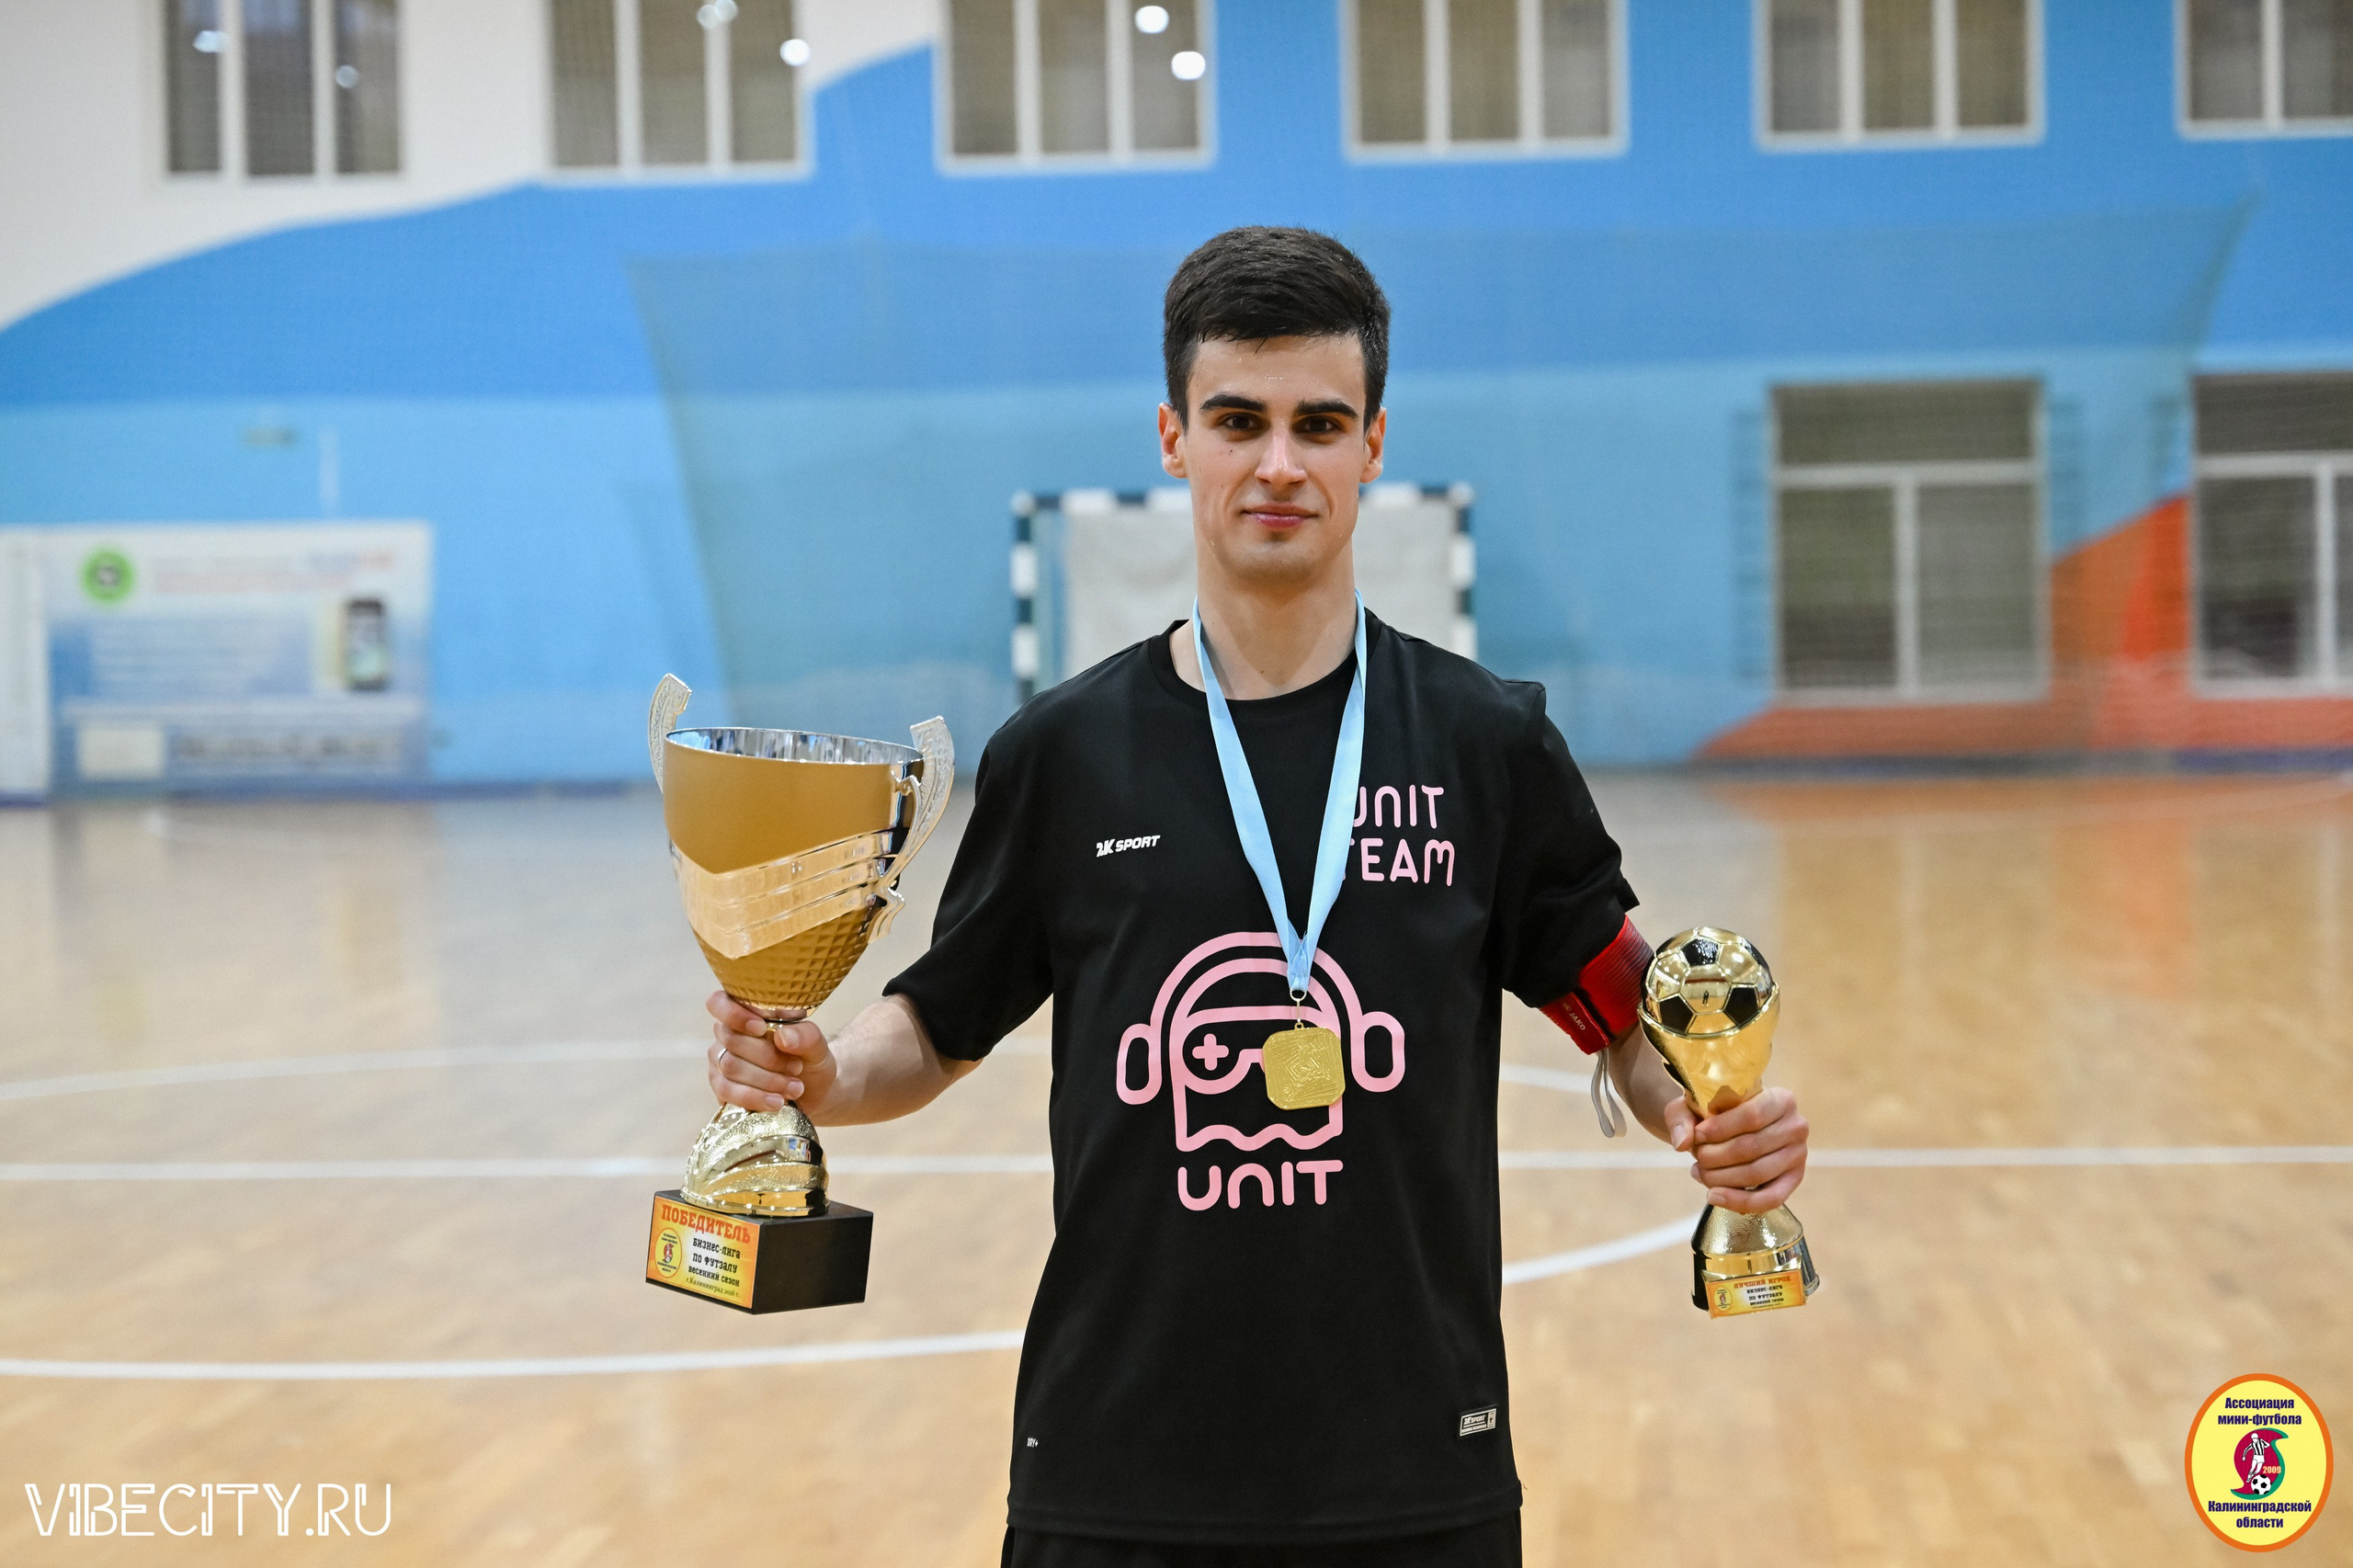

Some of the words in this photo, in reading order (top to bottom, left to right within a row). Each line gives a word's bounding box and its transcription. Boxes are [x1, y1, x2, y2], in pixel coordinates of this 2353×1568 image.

[1115, 835, 1161, 852] SPORT
[1344, 837, 1455, 887] EAM
[1569, 1013, 1586, 1030] JAKO
[661, 1204, 751, 1244] ПОБЕДИТЕЛЬ
[721, 1276, 740, 1287] сезон
